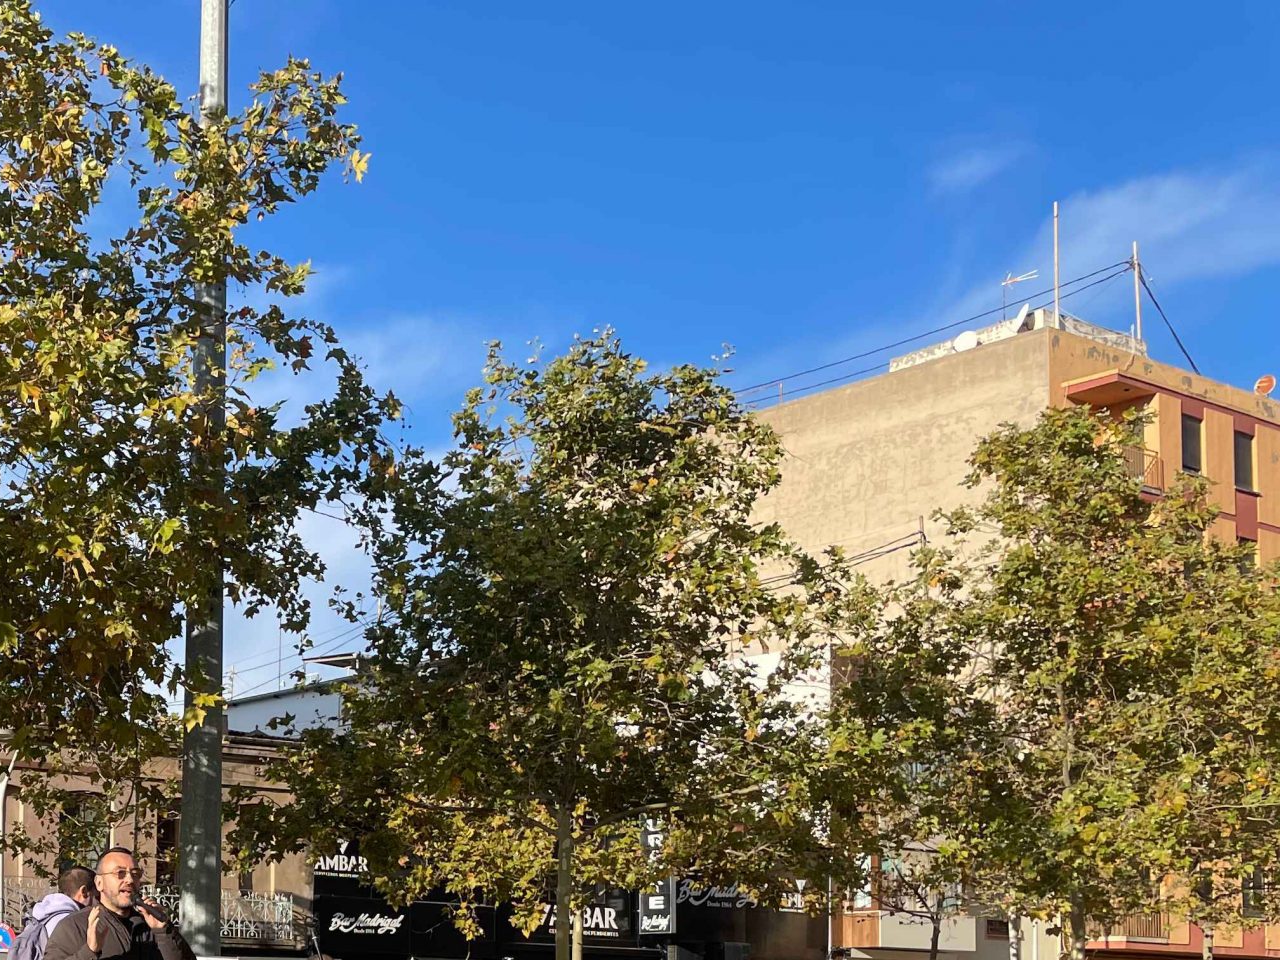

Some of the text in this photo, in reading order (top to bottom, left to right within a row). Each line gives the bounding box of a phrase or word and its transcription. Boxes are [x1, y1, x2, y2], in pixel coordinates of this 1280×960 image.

[315, 855, 369, 872] AMBAR
[328, 912, 405, 934] Bar Madrigal
